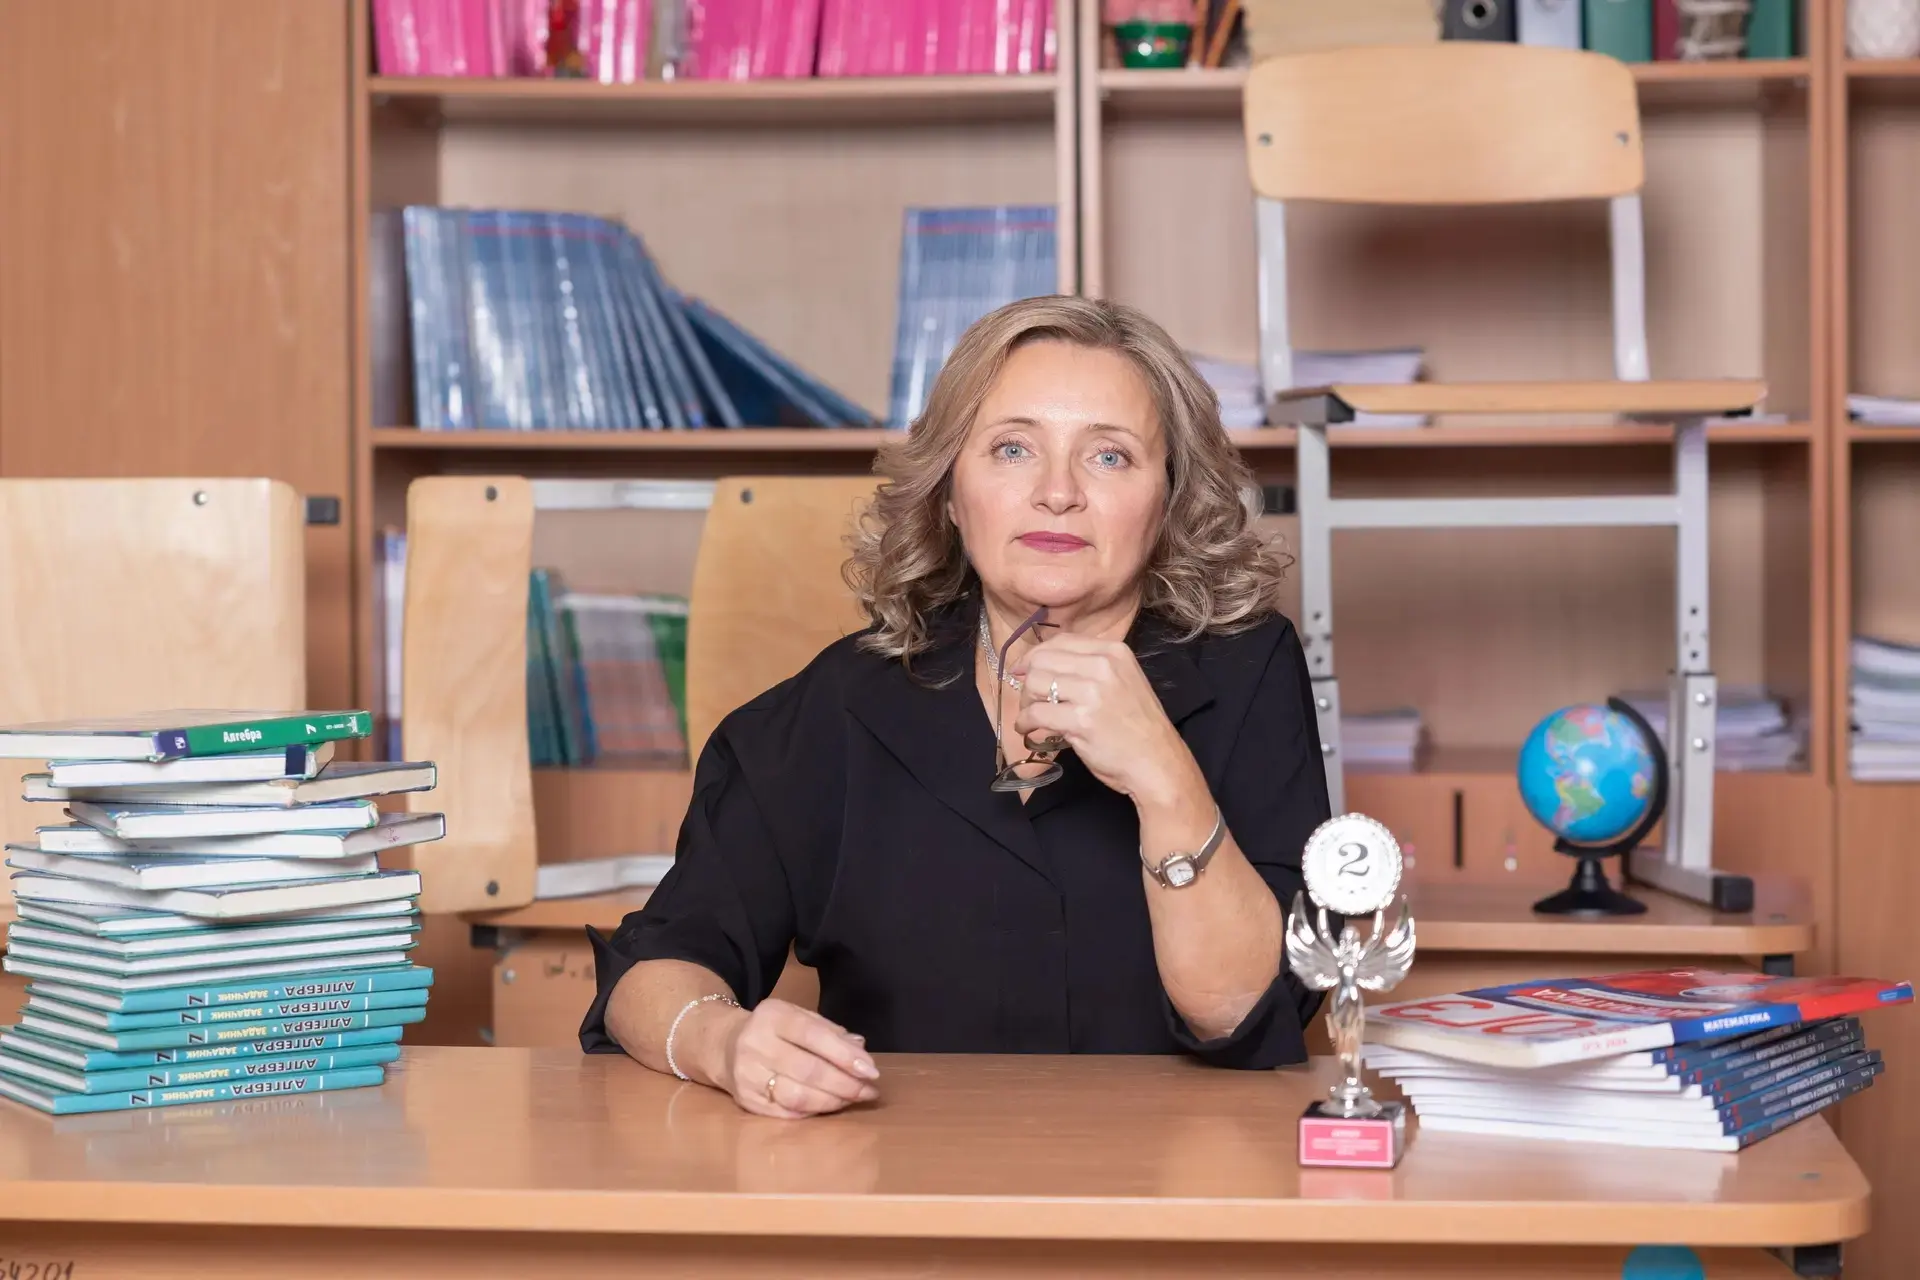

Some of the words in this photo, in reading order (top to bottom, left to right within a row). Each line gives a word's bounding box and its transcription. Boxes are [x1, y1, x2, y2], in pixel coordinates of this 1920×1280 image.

[223, 728, 262, 743] Алгебра
[1337, 842, 1370, 876] 2
[217, 989, 269, 1002] ЗАДАЧНИК
[285, 981, 355, 997] АЛГЕБРА
[188, 994, 204, 1006] 7
[279, 999, 352, 1015] АЛГЕБРА
[181, 1012, 197, 1024] 7
[211, 1007, 263, 1021] ЗАДАЧНИК
[283, 1017, 352, 1034] АЛГЕБРА
[1703, 1012, 1771, 1033] МАТЕМАТИКА
[188, 1033, 204, 1044] 7
[216, 1026, 268, 1040] ЗАДАЧНИК
[186, 1045, 238, 1059] ЗАДАЧНИК
[253, 1037, 325, 1053] АЛГЕБРА
[156, 1051, 172, 1063] 7
[245, 1058, 317, 1075] АЛГЕБРА
[148, 1074, 164, 1086] 7
[177, 1068, 230, 1082] ЗАДАЧНИК
[232, 1078, 306, 1095] АЛГЕБРА
[131, 1093, 149, 1106] 7
[161, 1088, 216, 1102] ЗАДАЧНИК
